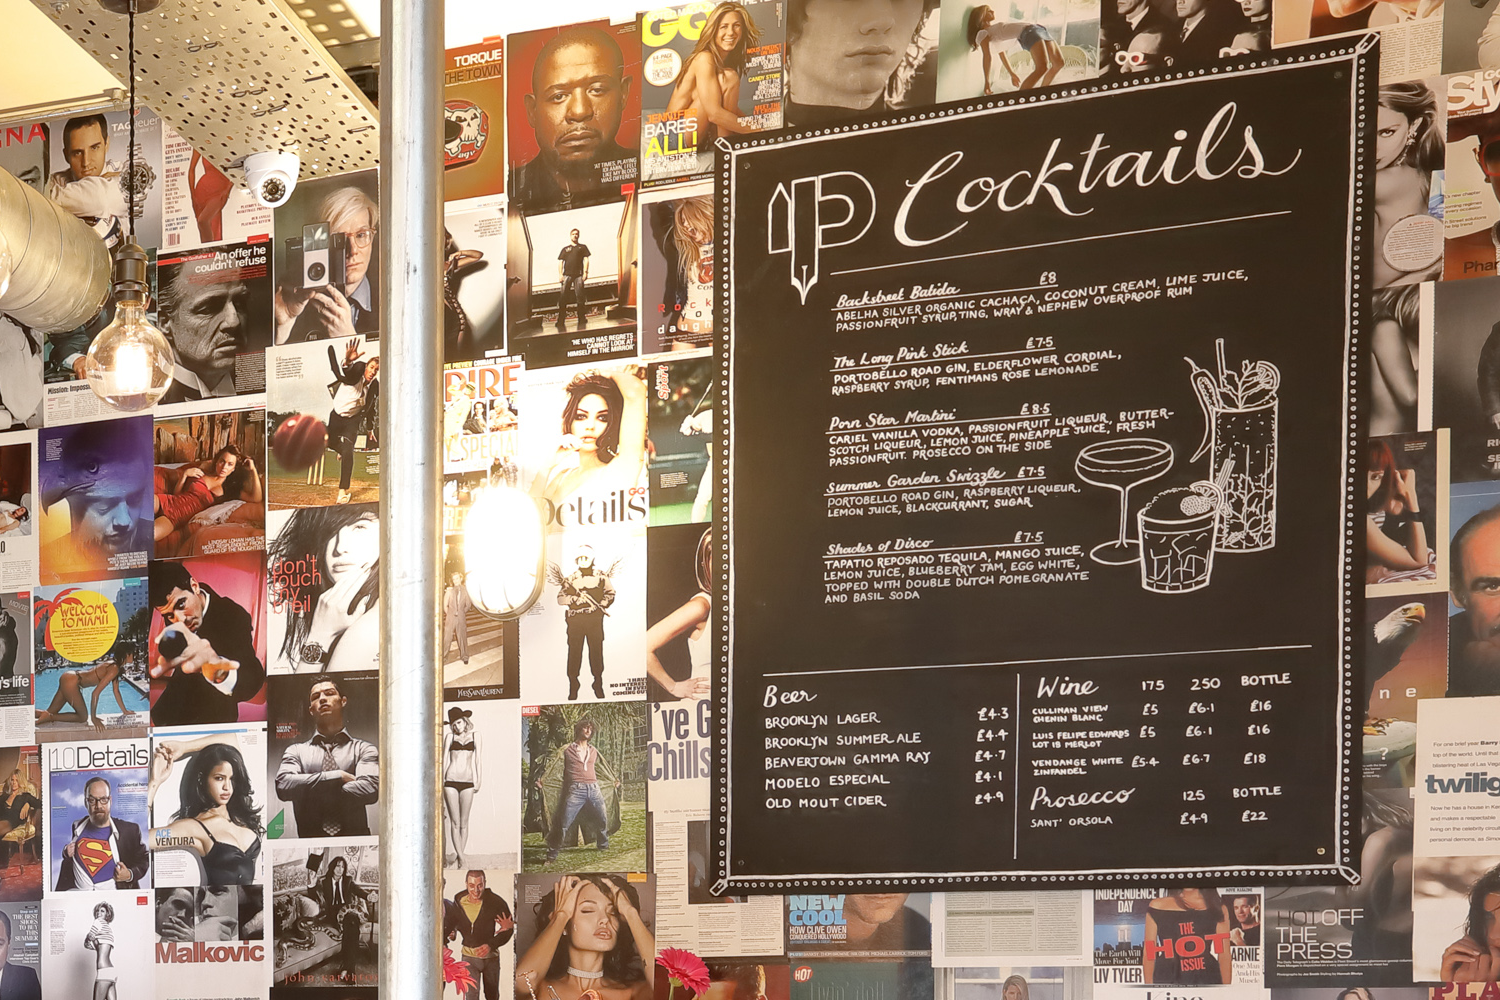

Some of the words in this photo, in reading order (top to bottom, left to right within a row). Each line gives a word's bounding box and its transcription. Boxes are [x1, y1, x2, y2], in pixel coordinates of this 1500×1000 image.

[454, 49, 501, 67] TORQUE
[645, 118, 697, 138] BARES
[645, 131, 697, 158] ALL!
[892, 100, 1303, 248] Cocktails
[214, 252, 227, 261] An
[229, 248, 251, 259] offer
[254, 246, 266, 255] he
[195, 260, 232, 273] couldn't
[235, 256, 266, 267] refuse
[836, 289, 904, 308] Backstreet
[910, 283, 961, 299] Batida
[1039, 272, 1057, 285] £8
[834, 356, 856, 368] The
[860, 352, 894, 368] Long
[898, 347, 928, 362] Pink
[933, 341, 969, 356] Stick
[834, 369, 908, 384] PORTOBELLO
[911, 365, 941, 377] ROAD
[946, 362, 971, 374] GIN,
[974, 354, 1057, 371] ELDERFLOWER
[1064, 350, 1122, 362] CORDIAL,
[829, 416, 862, 430] Porn
[865, 413, 899, 428] Star
[905, 409, 956, 424] Martini
[826, 544, 873, 555] Shades
[877, 541, 892, 553] of
[894, 537, 934, 550] Disco
[13, 676, 29, 688] life
[1037, 676, 1099, 699] Wine
[1142, 680, 1165, 690] 175
[1190, 678, 1221, 690] 250
[1241, 673, 1291, 686] BOTTLE
[763, 685, 817, 707] Beer
[765, 714, 828, 729] BROOKLYN
[837, 712, 881, 725] LAGER
[765, 778, 820, 790] MODELO
[829, 774, 890, 786] ESPECIAL
[766, 798, 791, 809] OLD
[799, 798, 839, 808] MOUT
[845, 795, 887, 807] CIDER
[1030, 786, 1136, 810] Prosecco
[1183, 790, 1205, 800] 125
[1233, 786, 1282, 798] BOTTLE
[1030, 818, 1062, 828] SANT'
[1069, 816, 1113, 826] ORSOLA
[1242, 810, 1268, 822] £22
[156, 829, 171, 838] ACE
[156, 837, 195, 846] VENTURA
[790, 894, 845, 910] NEW
[789, 910, 846, 925] COOL
[1231, 948, 1259, 961] ARNIE
[1094, 969, 1109, 983] LIV
[1112, 968, 1142, 983] TYLER
